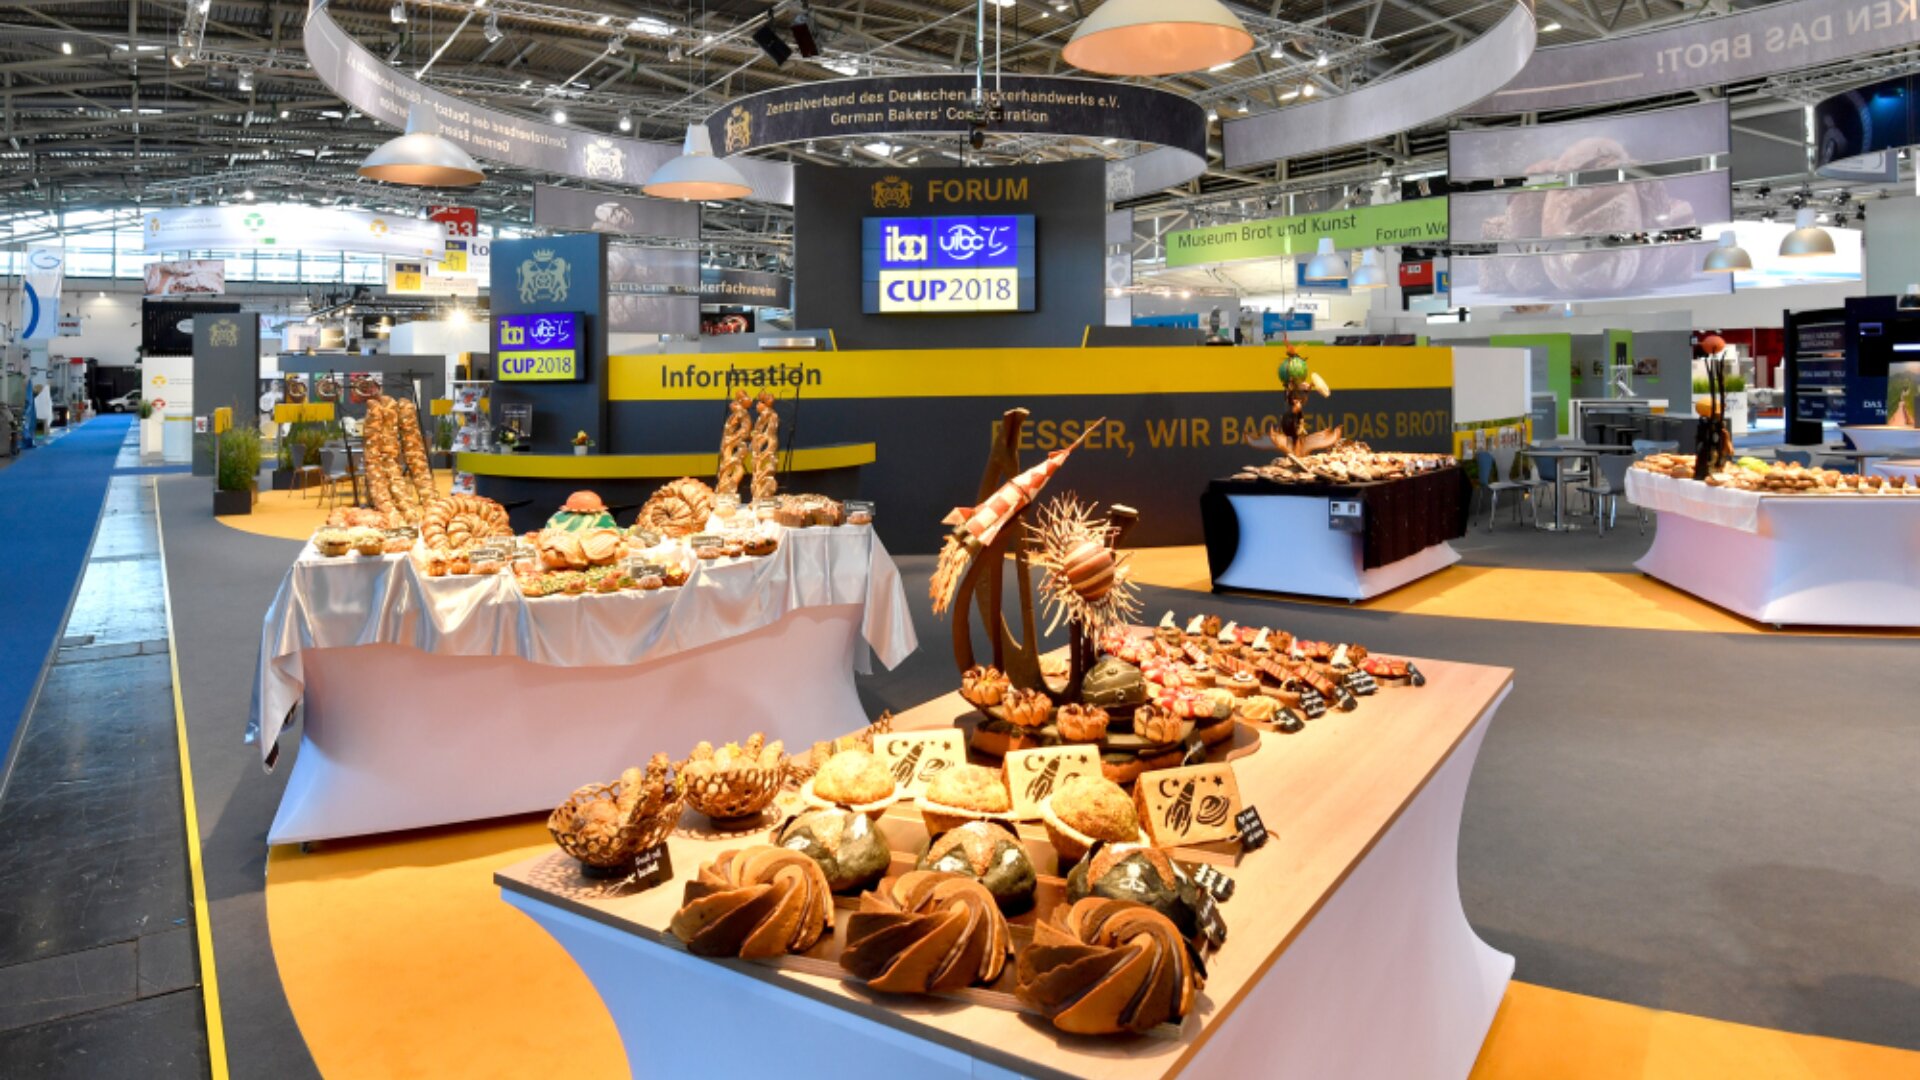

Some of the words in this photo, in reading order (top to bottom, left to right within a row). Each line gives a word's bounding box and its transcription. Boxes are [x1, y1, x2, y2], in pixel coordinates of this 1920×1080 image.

[766, 91, 855, 117] Zentralverband
[859, 90, 884, 104] des
[888, 87, 966, 103] Deutschen
[1098, 95, 1120, 109] e.V.
[831, 110, 884, 126] German
[928, 177, 1029, 202] FORUM
[885, 225, 928, 262] iba
[1178, 226, 1238, 249] Museum
[1241, 223, 1273, 240] Brot
[1277, 216, 1307, 237] und
[1311, 213, 1357, 231] Kunst
[1375, 226, 1422, 241] Forum
[661, 363, 823, 388] Information
[1146, 416, 1210, 449] WIR
[1344, 411, 1390, 440] DAS
